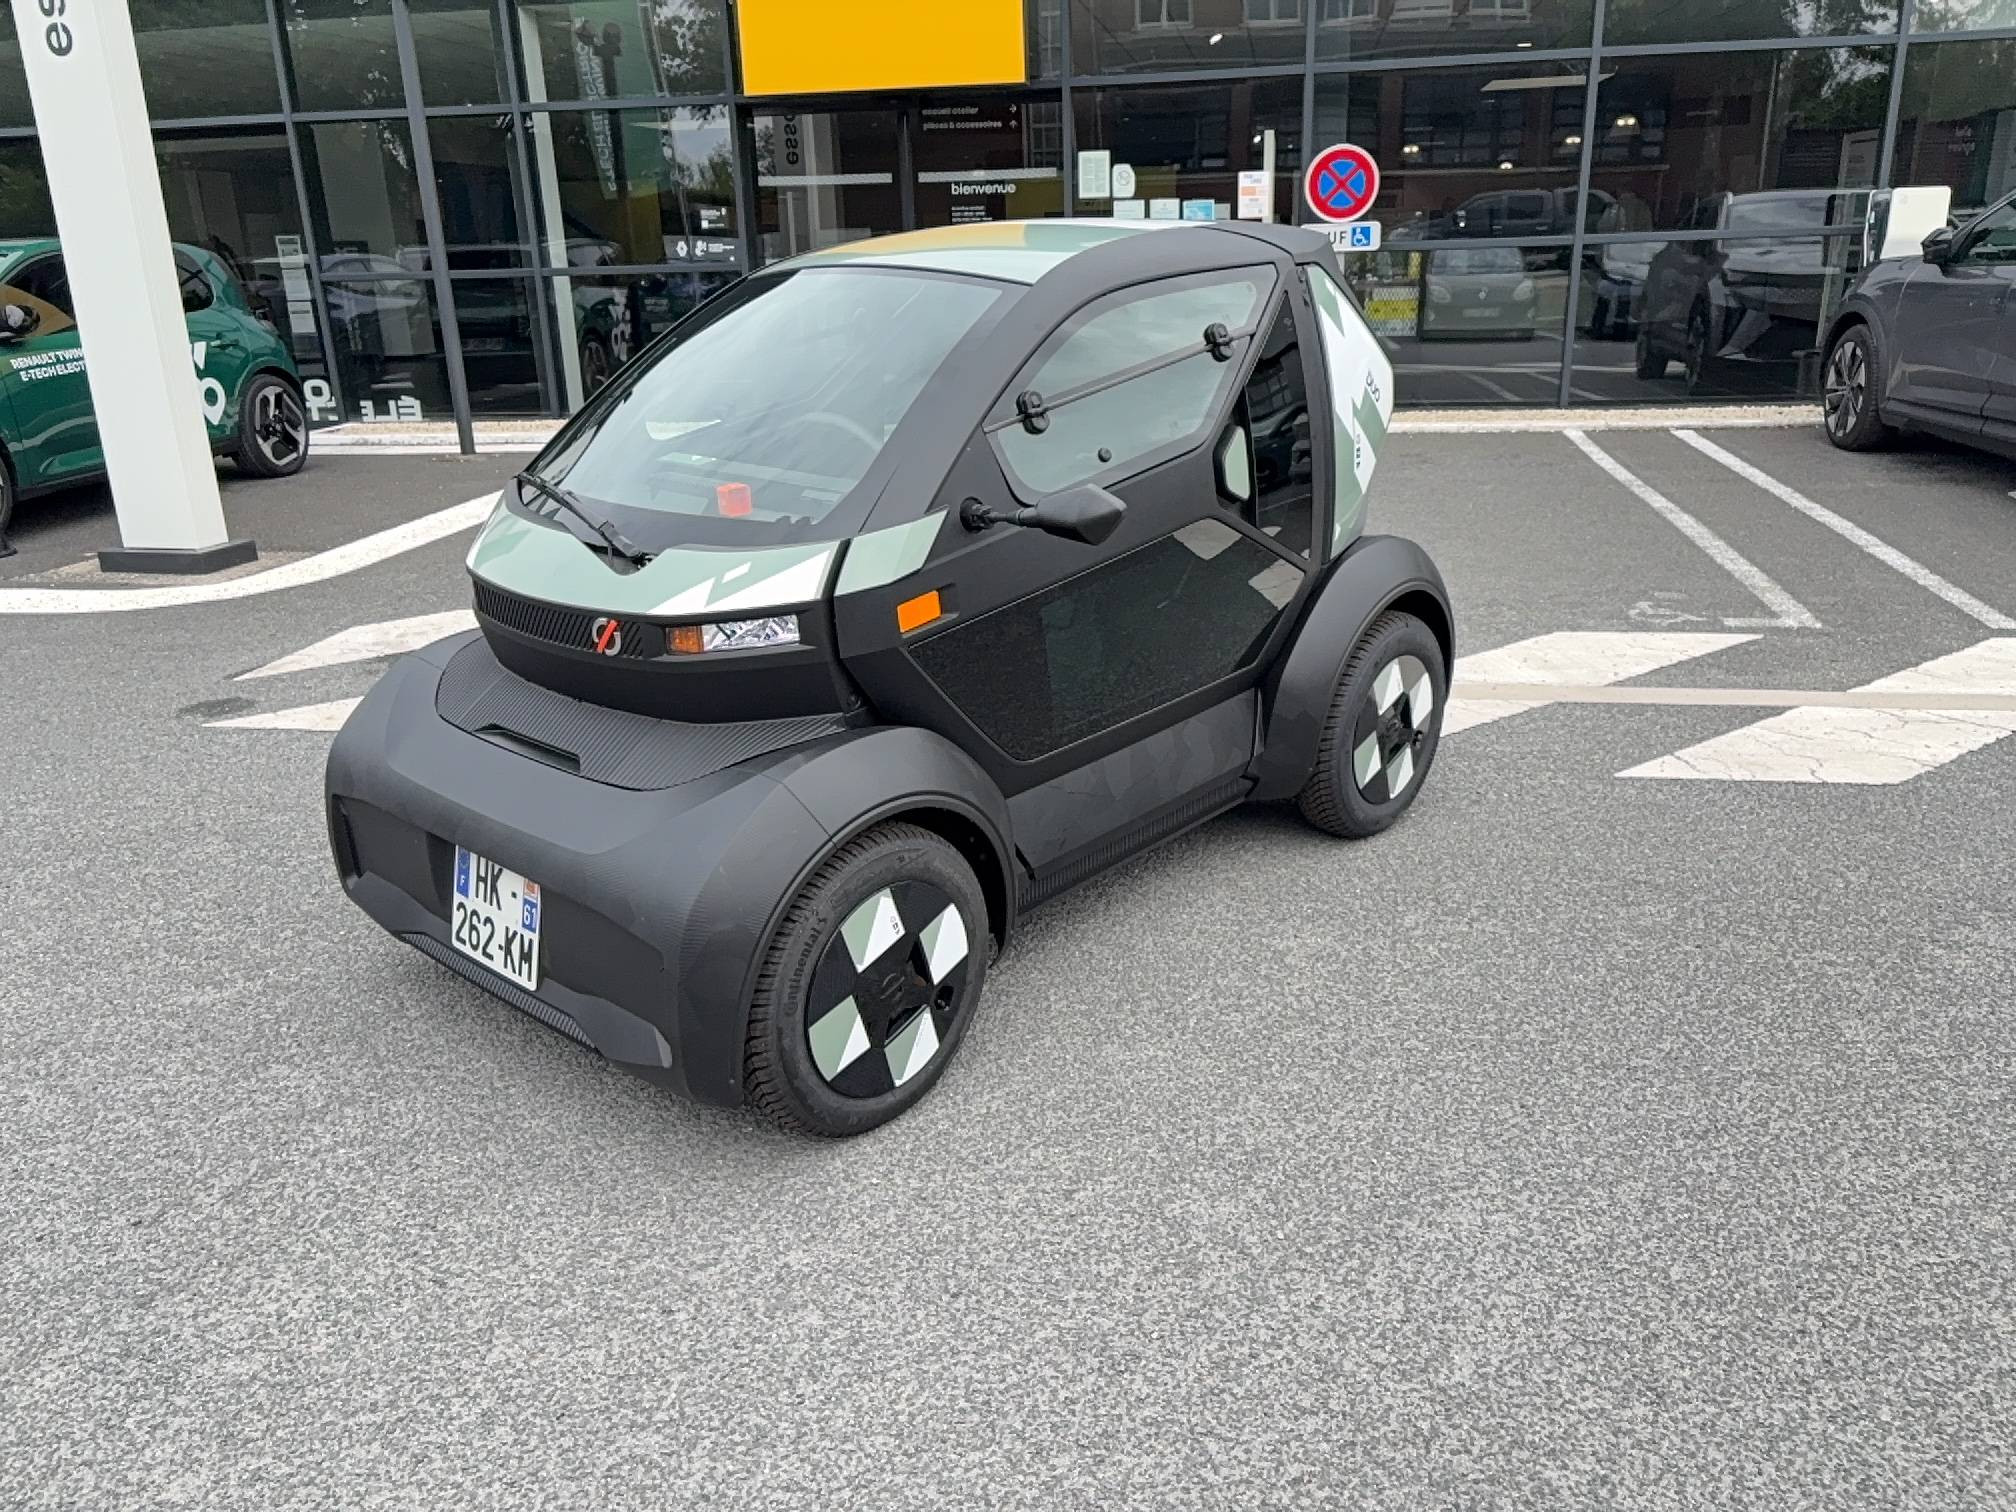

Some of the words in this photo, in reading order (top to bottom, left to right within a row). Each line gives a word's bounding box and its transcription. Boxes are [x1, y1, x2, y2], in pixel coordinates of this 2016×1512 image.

[951, 106, 979, 115] atelier
[951, 182, 1017, 195] bienvenue
[9, 351, 57, 369] RENAULT
[19, 366, 57, 382] E-TECH
[459, 875, 466, 887] F
[523, 903, 537, 931] 61
[455, 901, 535, 983] 262-KM
